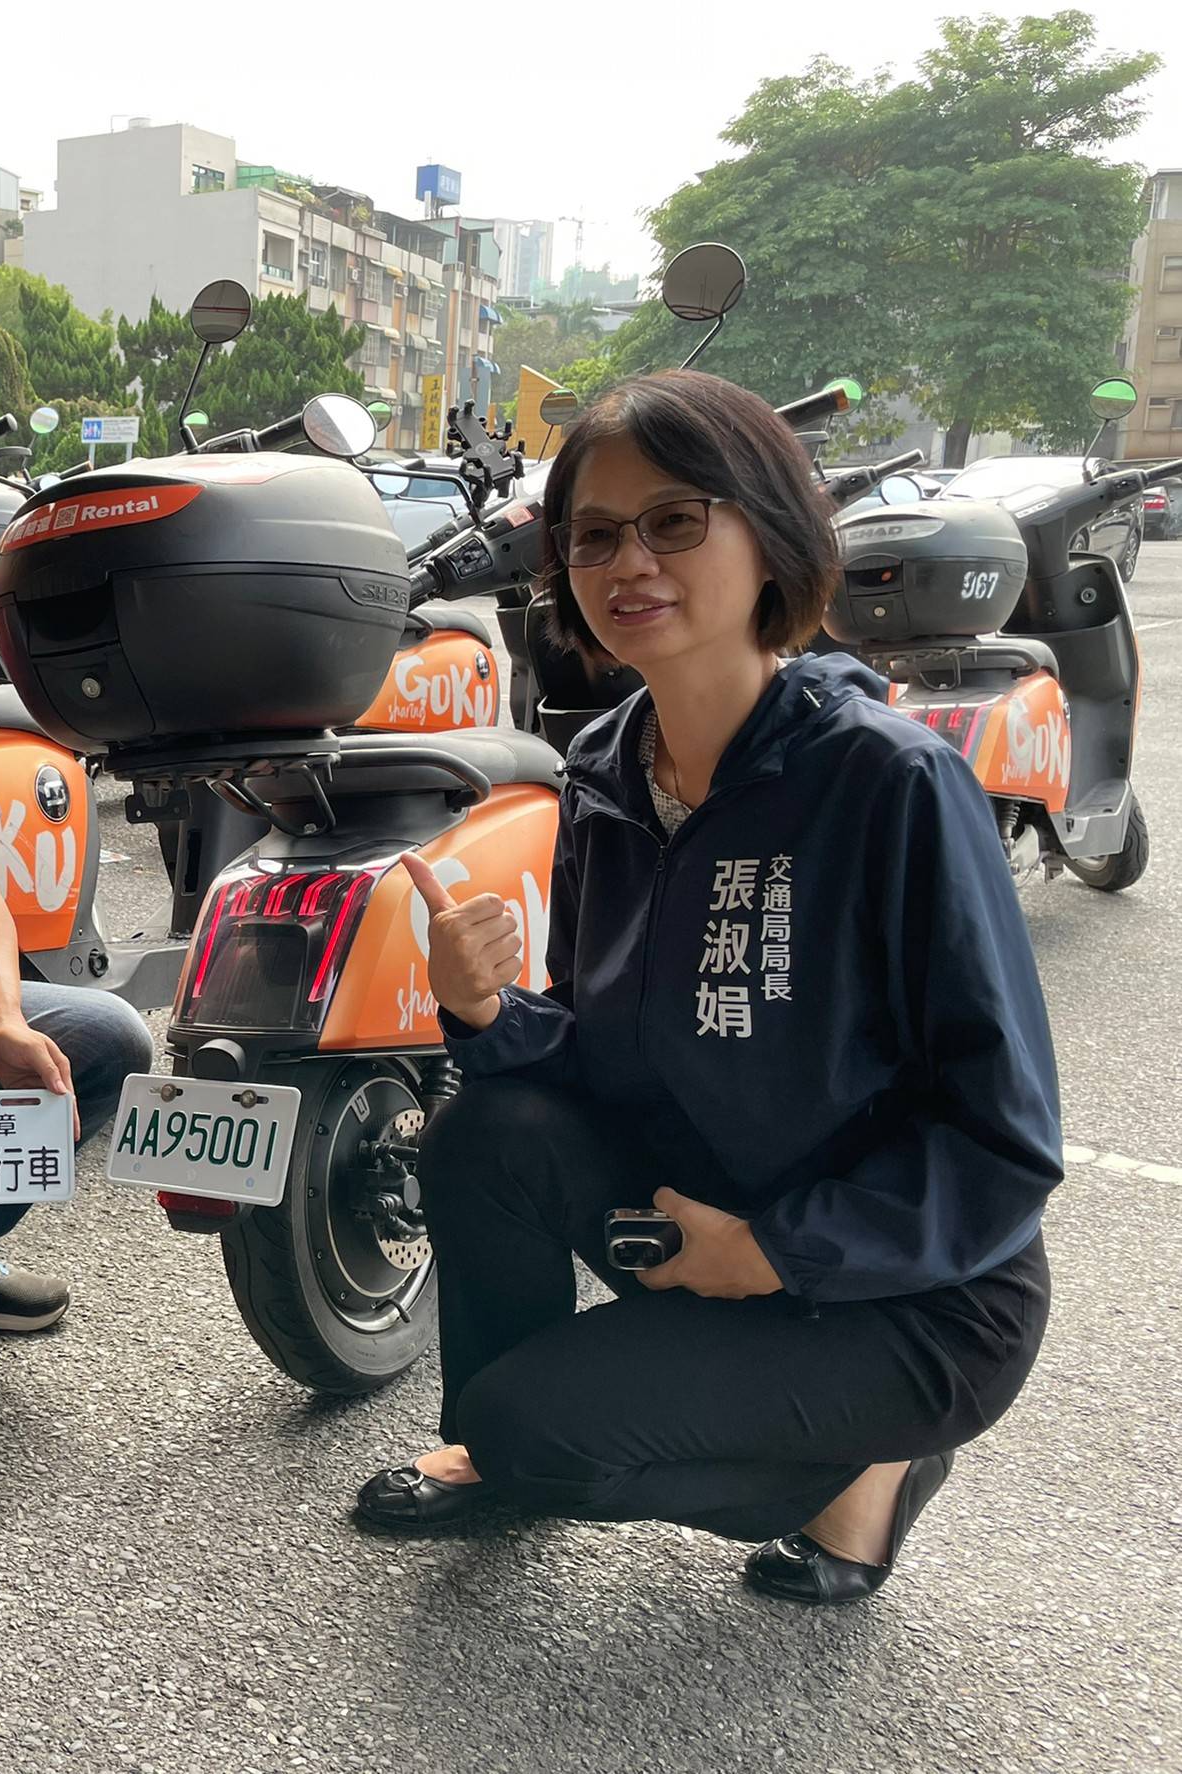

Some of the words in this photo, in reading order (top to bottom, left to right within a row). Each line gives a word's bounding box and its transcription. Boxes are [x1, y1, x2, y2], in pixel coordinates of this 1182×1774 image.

[81, 495, 159, 521] Rental
[961, 571, 999, 600] 967
[695, 859, 761, 1039] 張淑娟
[759, 853, 793, 1001] 交通局局長
[117, 1107, 279, 1172] AA95001
